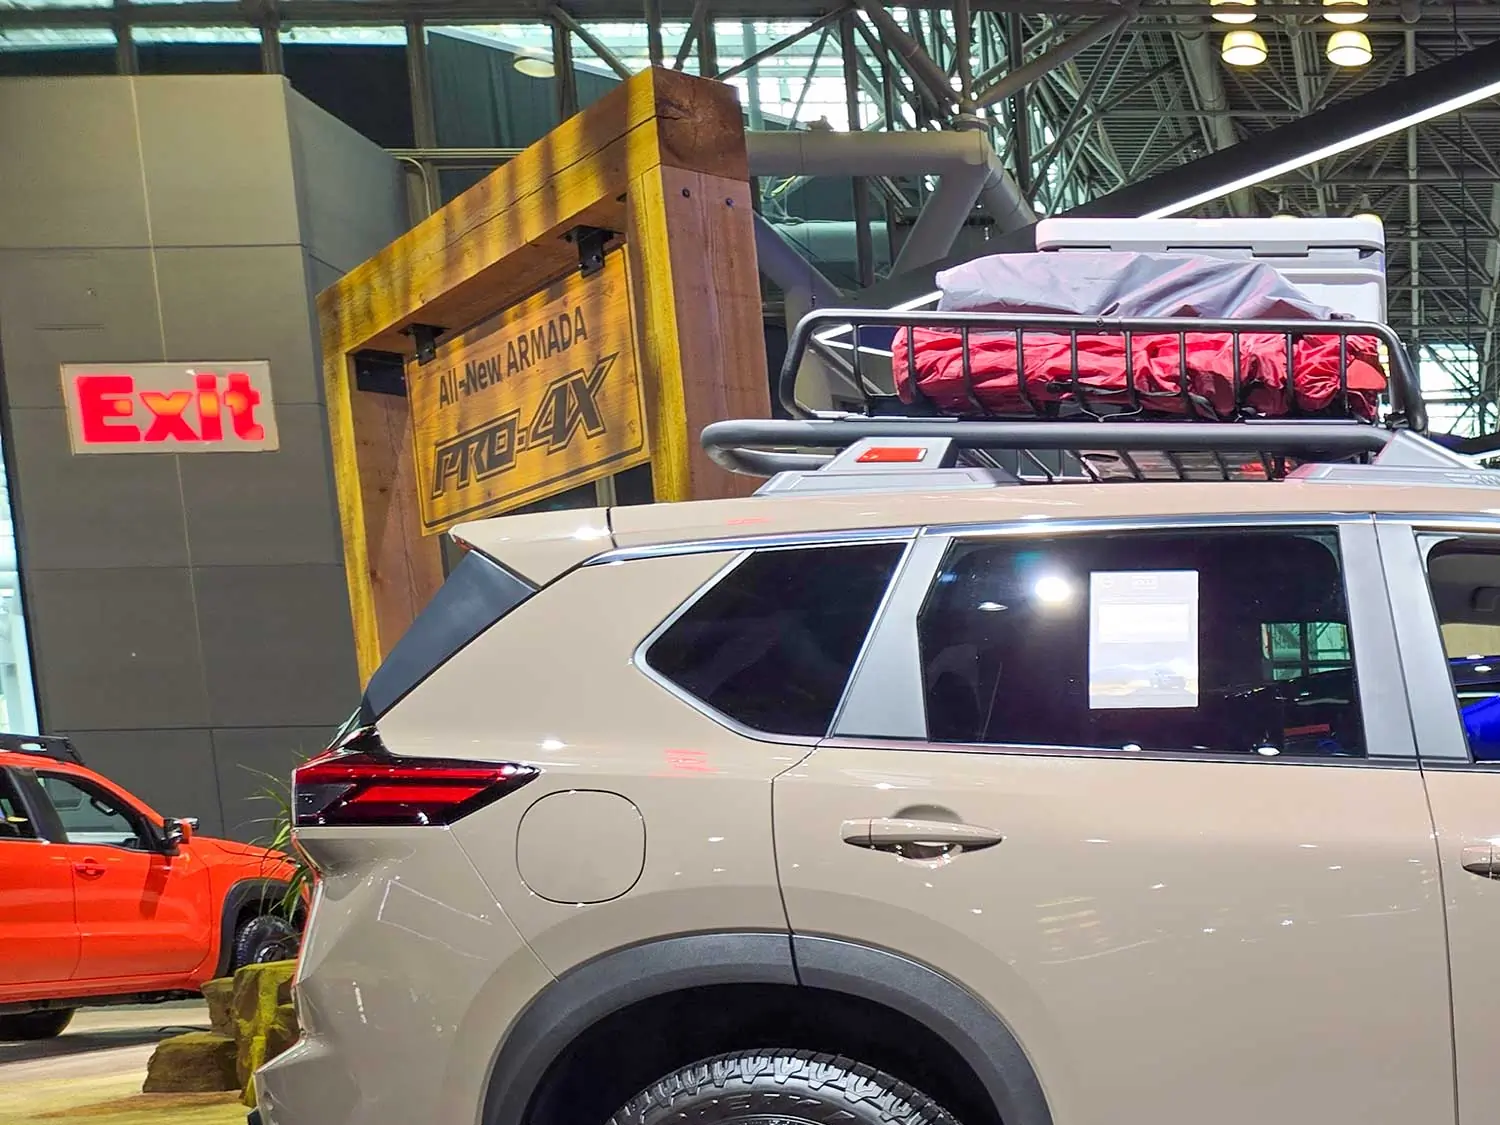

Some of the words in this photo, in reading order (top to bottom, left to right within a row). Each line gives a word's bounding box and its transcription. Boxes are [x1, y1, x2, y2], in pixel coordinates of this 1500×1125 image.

[75, 373, 265, 443] Exit
[439, 354, 501, 409] All-New
[506, 305, 588, 377] ARMADA
[432, 351, 620, 500] PRO-4X
